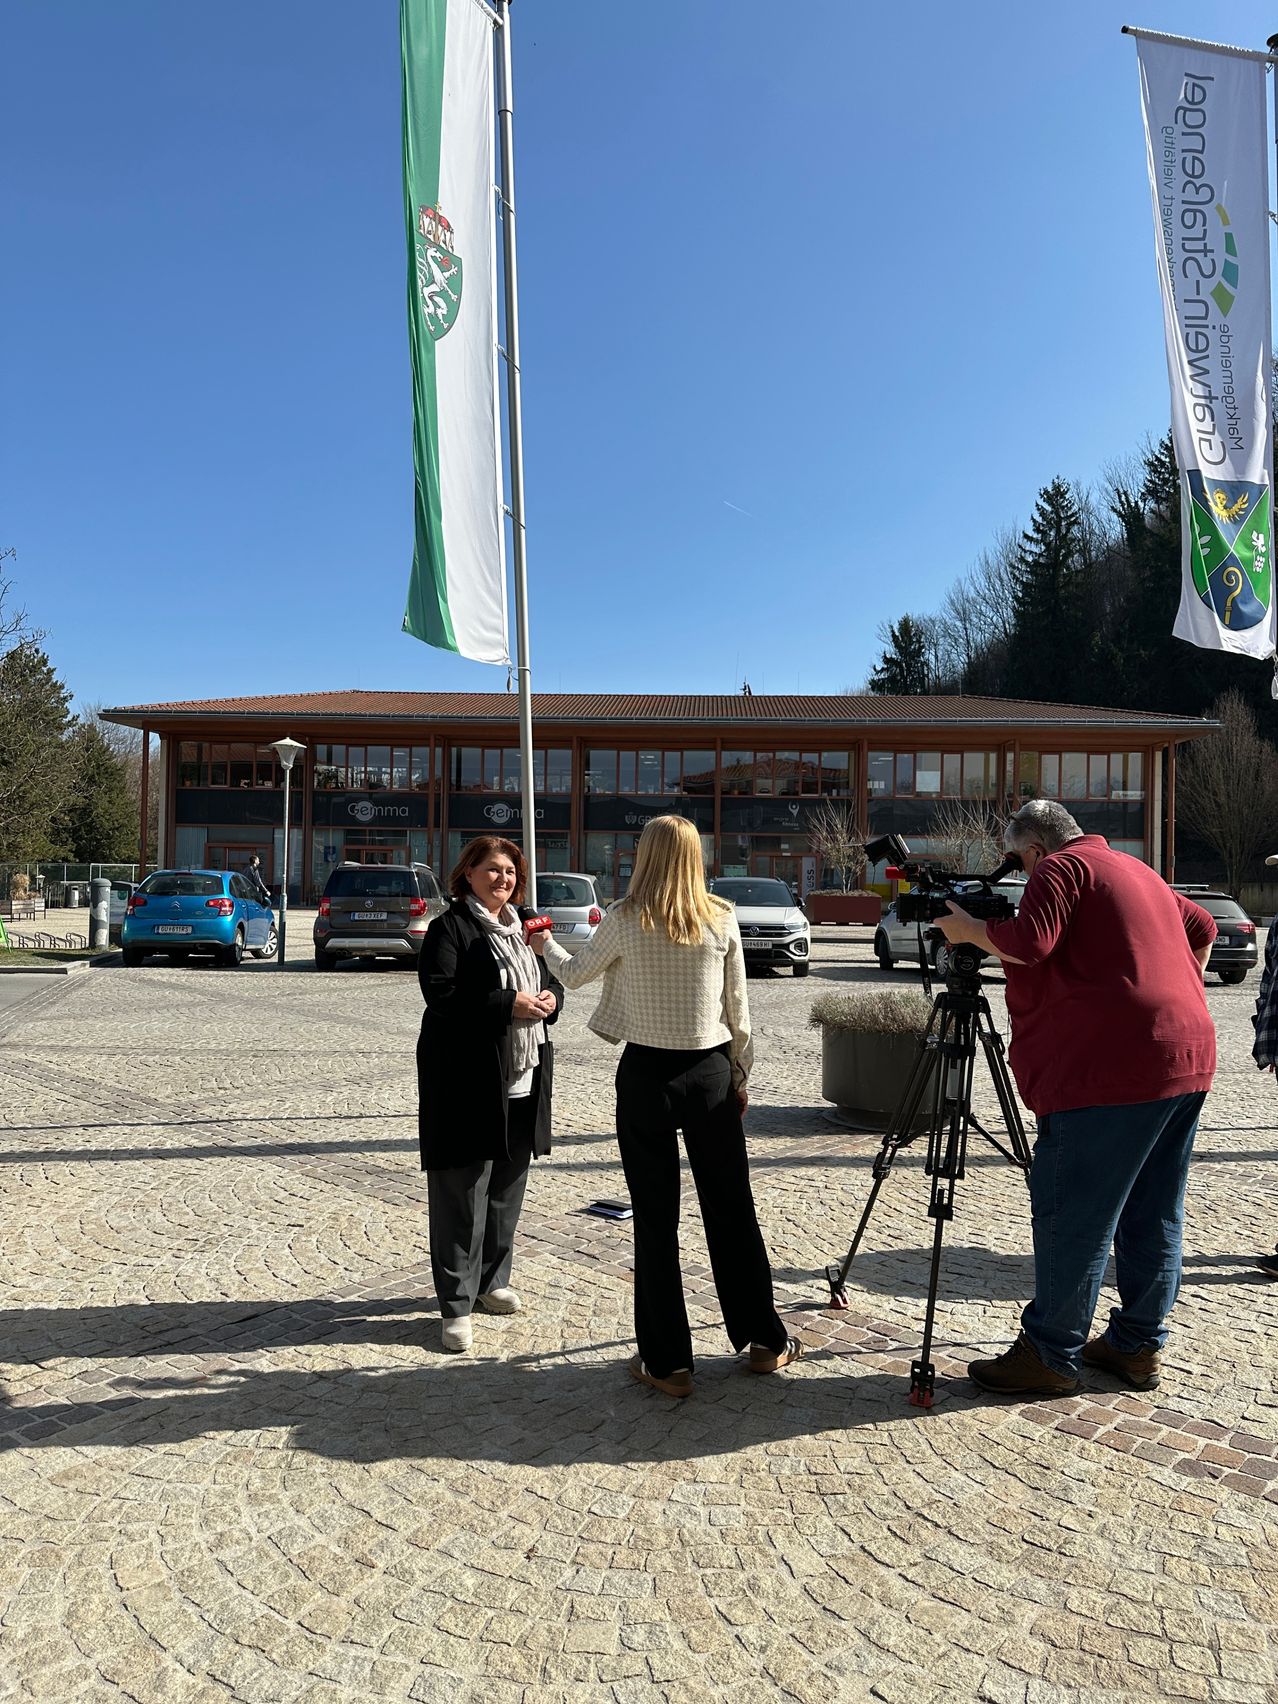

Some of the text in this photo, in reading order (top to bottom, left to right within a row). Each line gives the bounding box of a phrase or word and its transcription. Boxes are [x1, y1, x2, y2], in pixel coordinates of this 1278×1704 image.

[347, 801, 409, 820] Gemma
[483, 803, 545, 822] Gema
[527, 916, 548, 927] ORF
